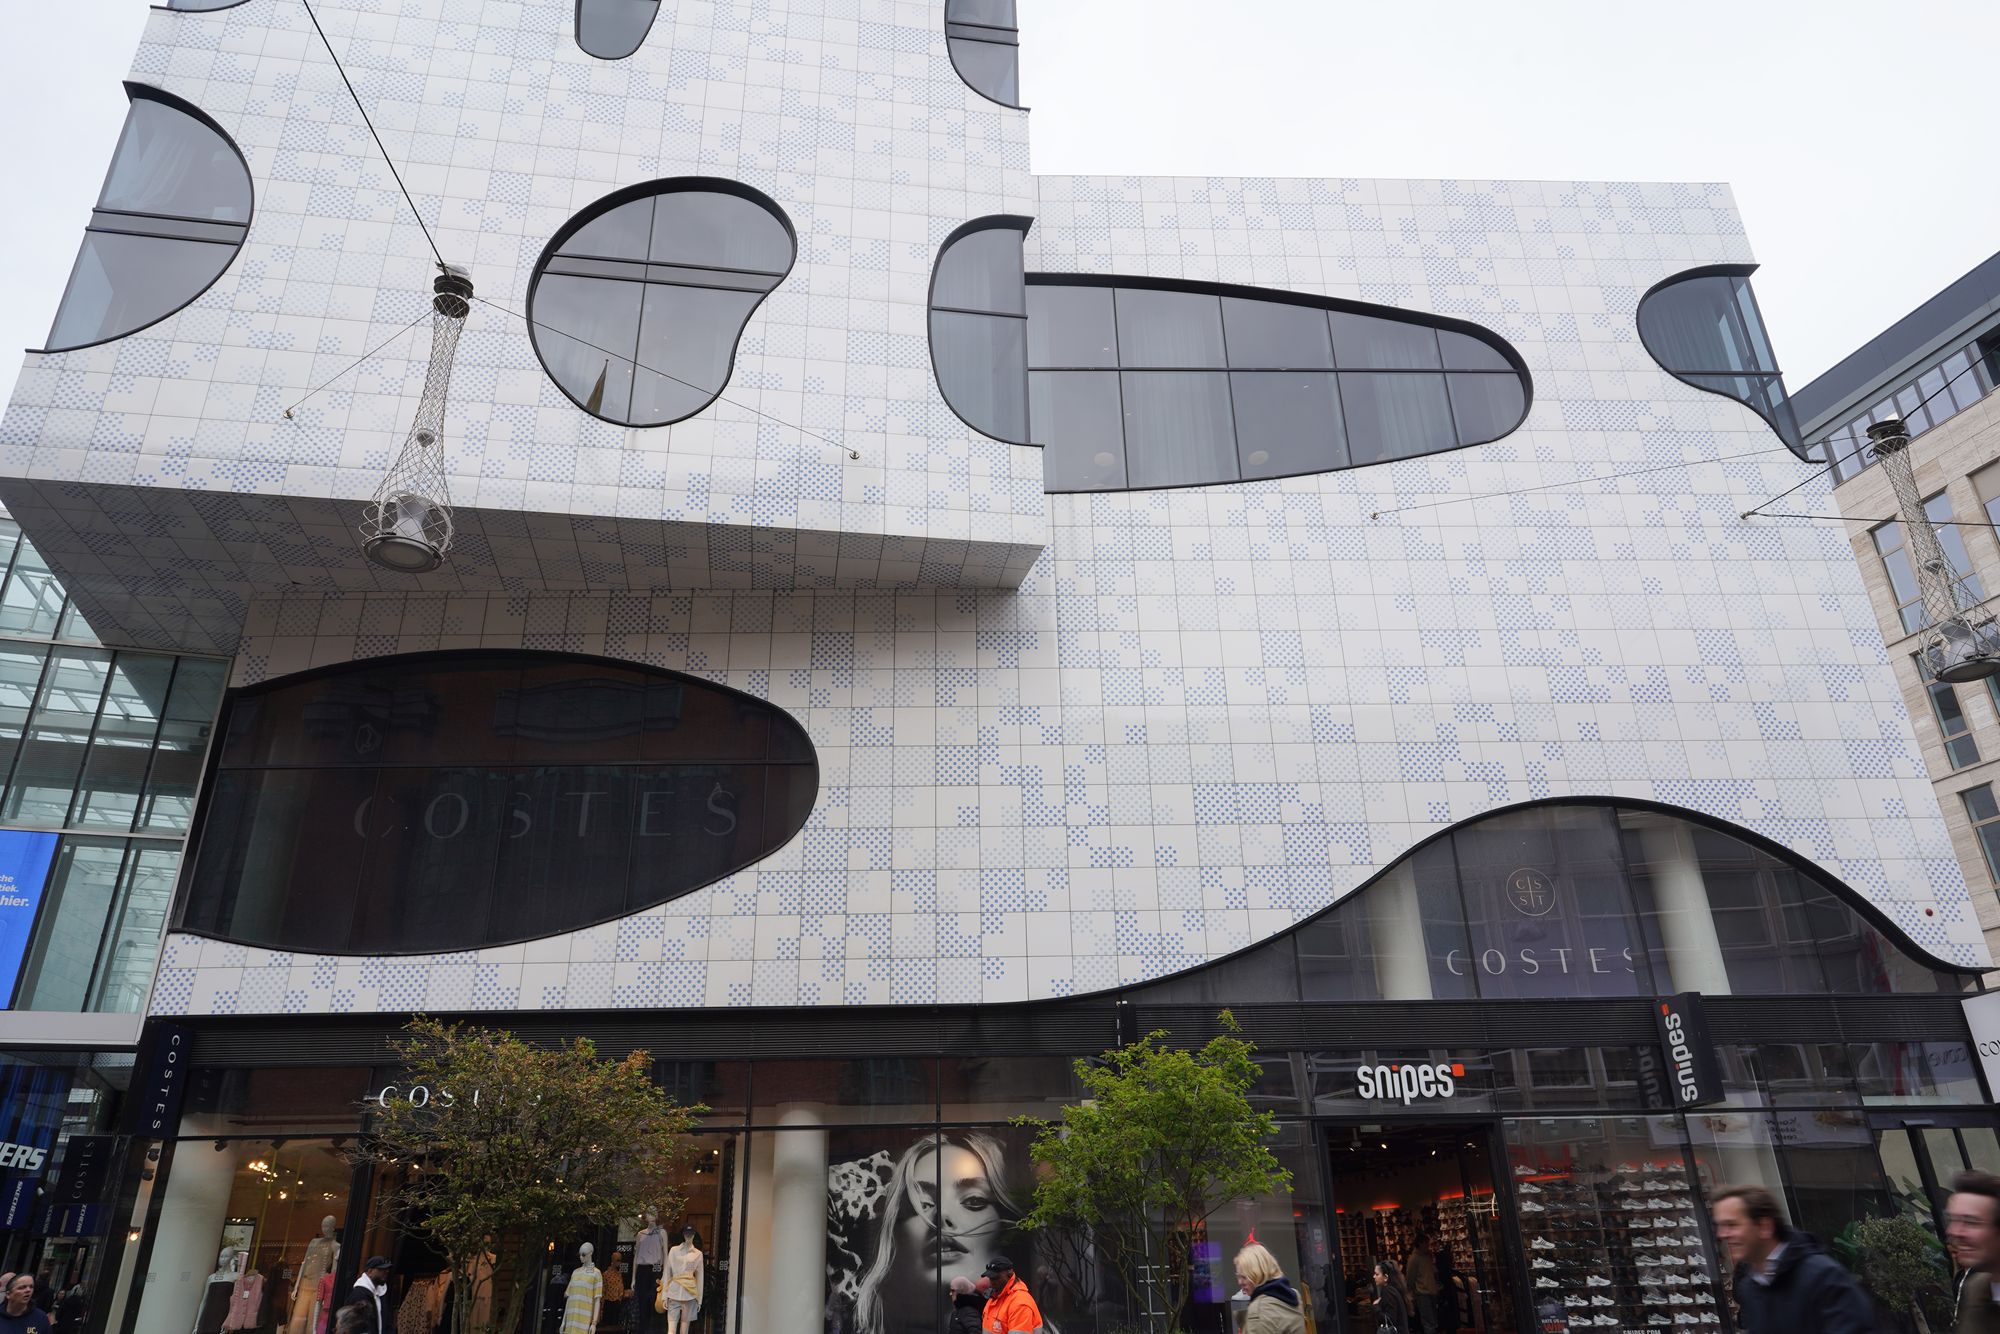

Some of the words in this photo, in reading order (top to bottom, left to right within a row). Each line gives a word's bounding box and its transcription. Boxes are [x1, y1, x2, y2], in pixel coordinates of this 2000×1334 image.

[1446, 947, 1635, 976] COSTES
[1665, 1013, 1698, 1102] snipes
[1979, 1039, 2000, 1057] CO
[153, 1034, 180, 1128] COSTES
[1357, 1064, 1454, 1105] snipes
[0, 1141, 48, 1170] ERS
[6, 1181, 23, 1226] SKECHERS
